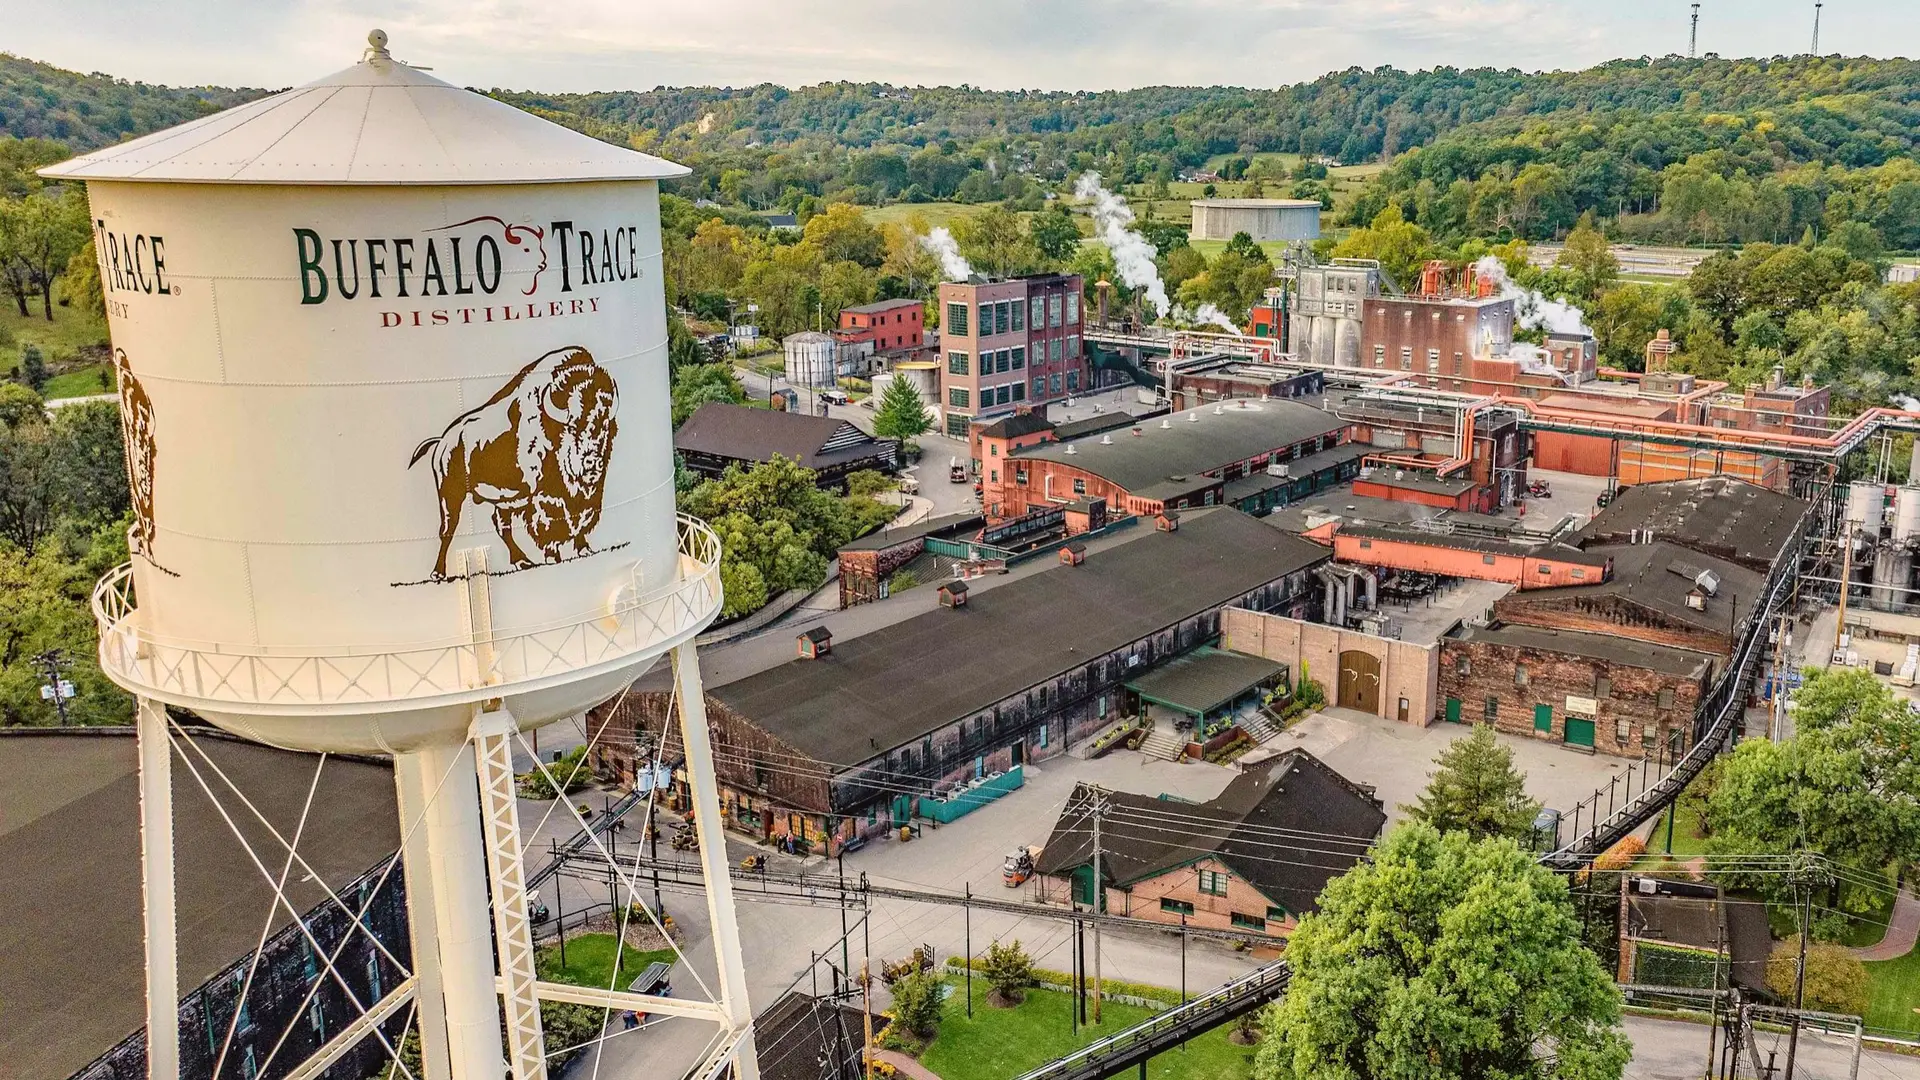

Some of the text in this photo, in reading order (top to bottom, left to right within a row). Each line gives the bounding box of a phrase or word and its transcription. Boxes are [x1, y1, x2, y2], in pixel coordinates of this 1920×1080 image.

[97, 219, 171, 295] TRACE
[292, 221, 639, 304] BUFFALO TRACE
[379, 296, 600, 328] DISTILLERY
